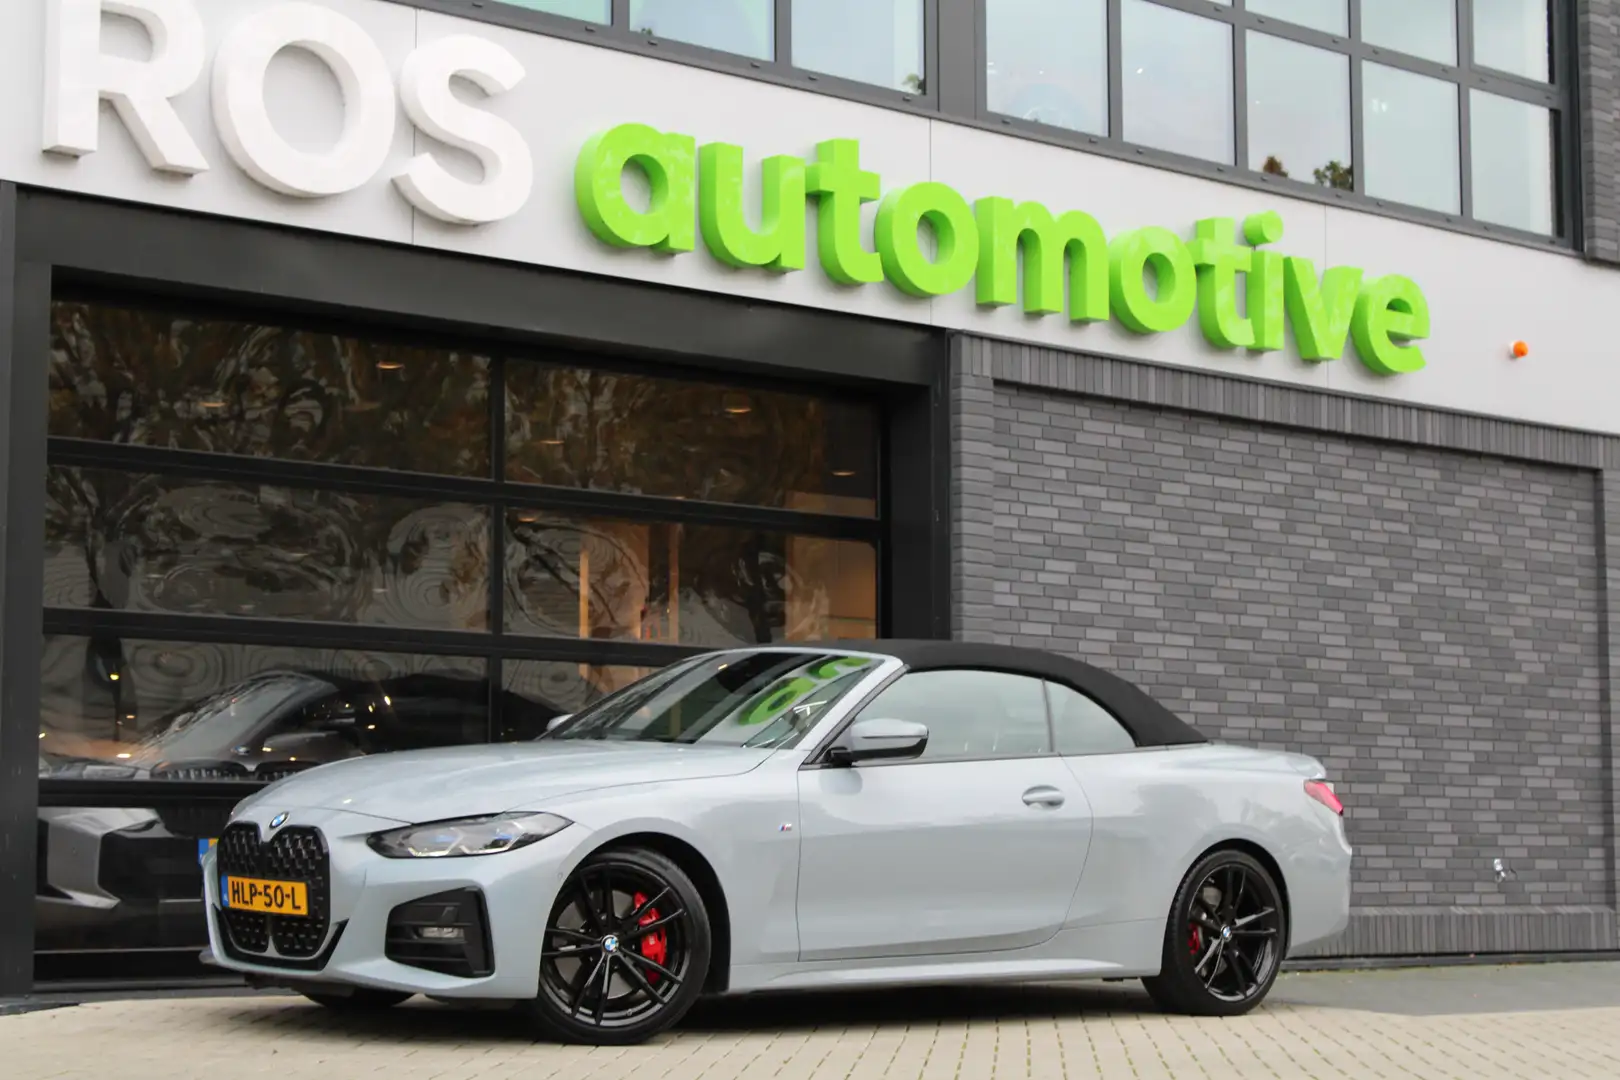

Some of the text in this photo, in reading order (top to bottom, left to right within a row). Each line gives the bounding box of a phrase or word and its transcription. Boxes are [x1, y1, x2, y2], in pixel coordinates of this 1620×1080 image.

[43, 0, 1431, 375] ROS automotive
[231, 881, 300, 909] HLP-50-L
